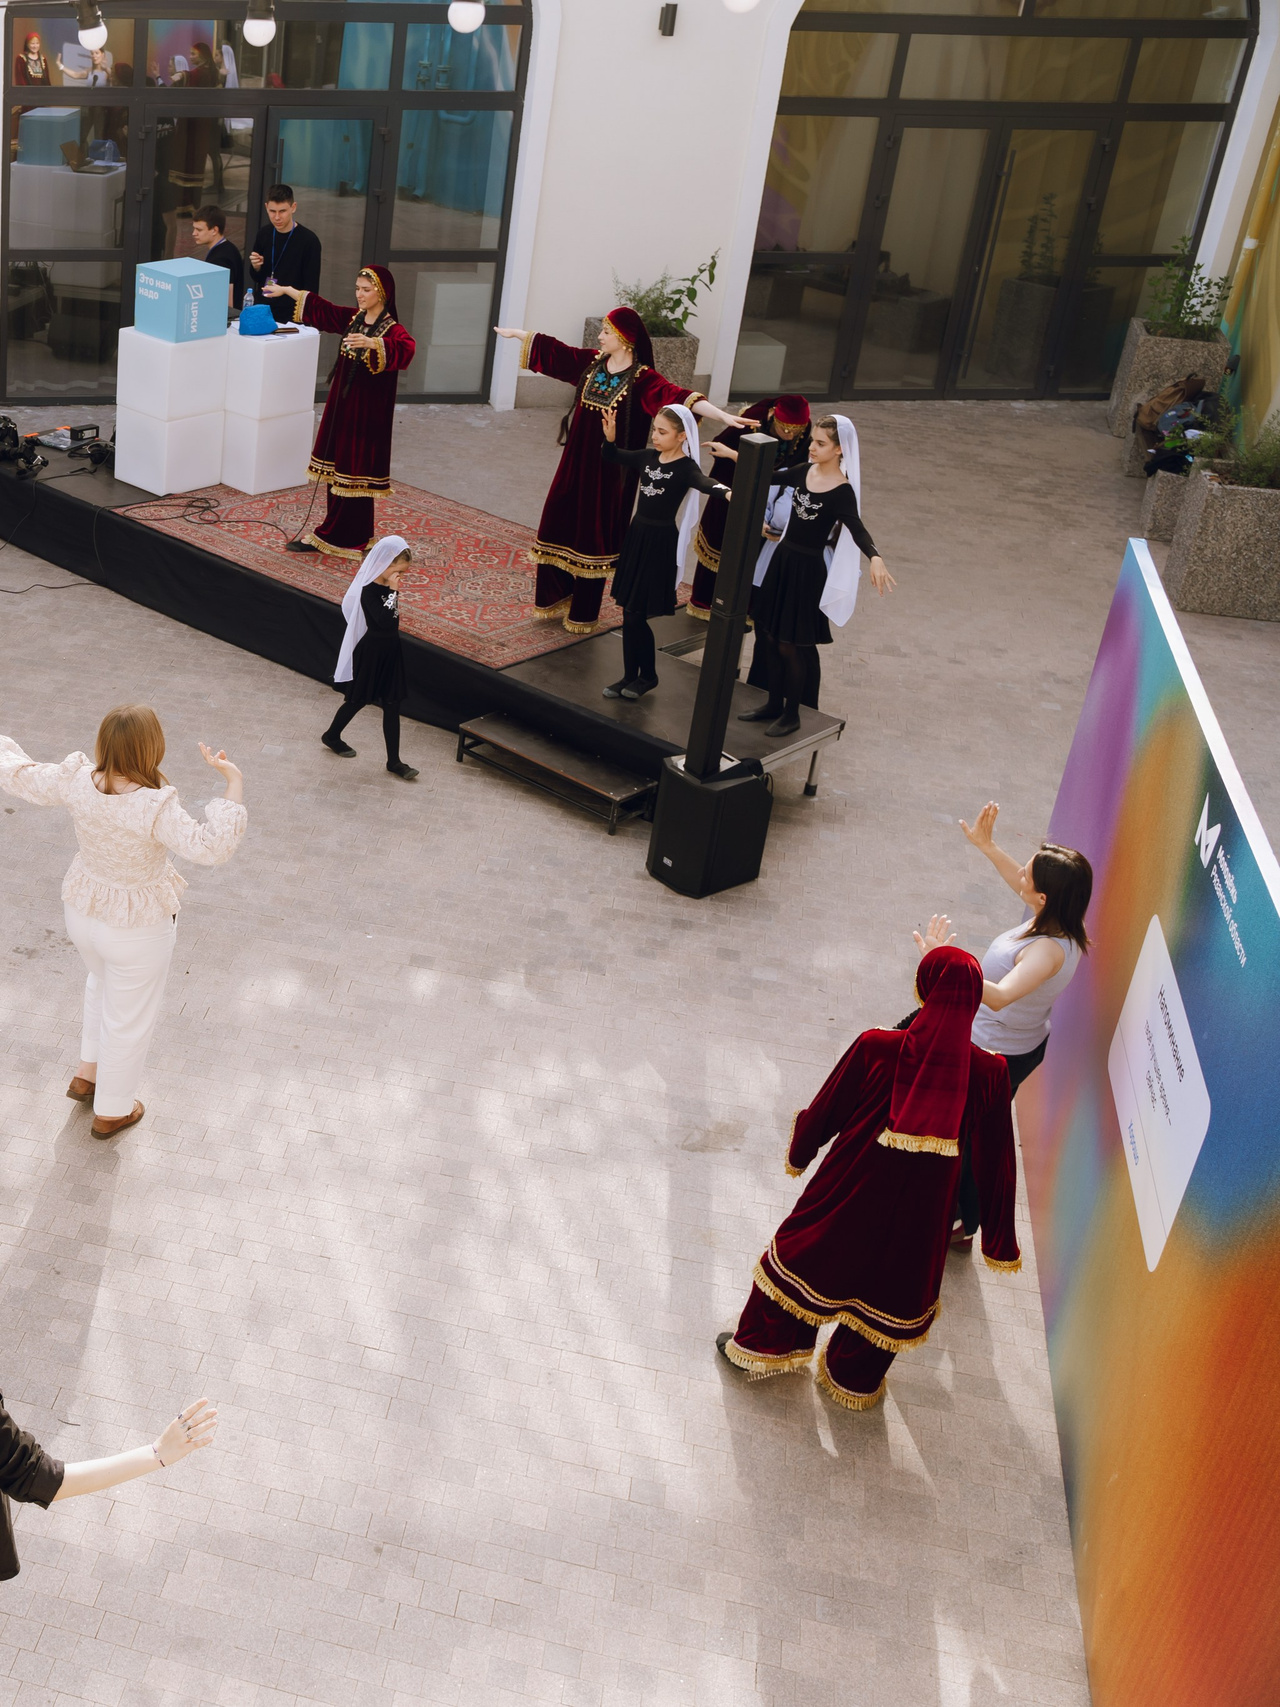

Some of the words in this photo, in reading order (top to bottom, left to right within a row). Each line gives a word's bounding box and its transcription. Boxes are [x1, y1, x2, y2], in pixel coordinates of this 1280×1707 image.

[138, 287, 159, 299] надо
[139, 272, 154, 286] Это
[155, 280, 172, 291] нам
[1210, 864, 1233, 924] Рязанской
[1229, 919, 1247, 968] области
[1157, 984, 1185, 1083] Напоминание
[1150, 1043, 1162, 1085] лучшее
[1158, 1082, 1170, 1118] время
[1128, 1118, 1140, 1167] Хорошо
